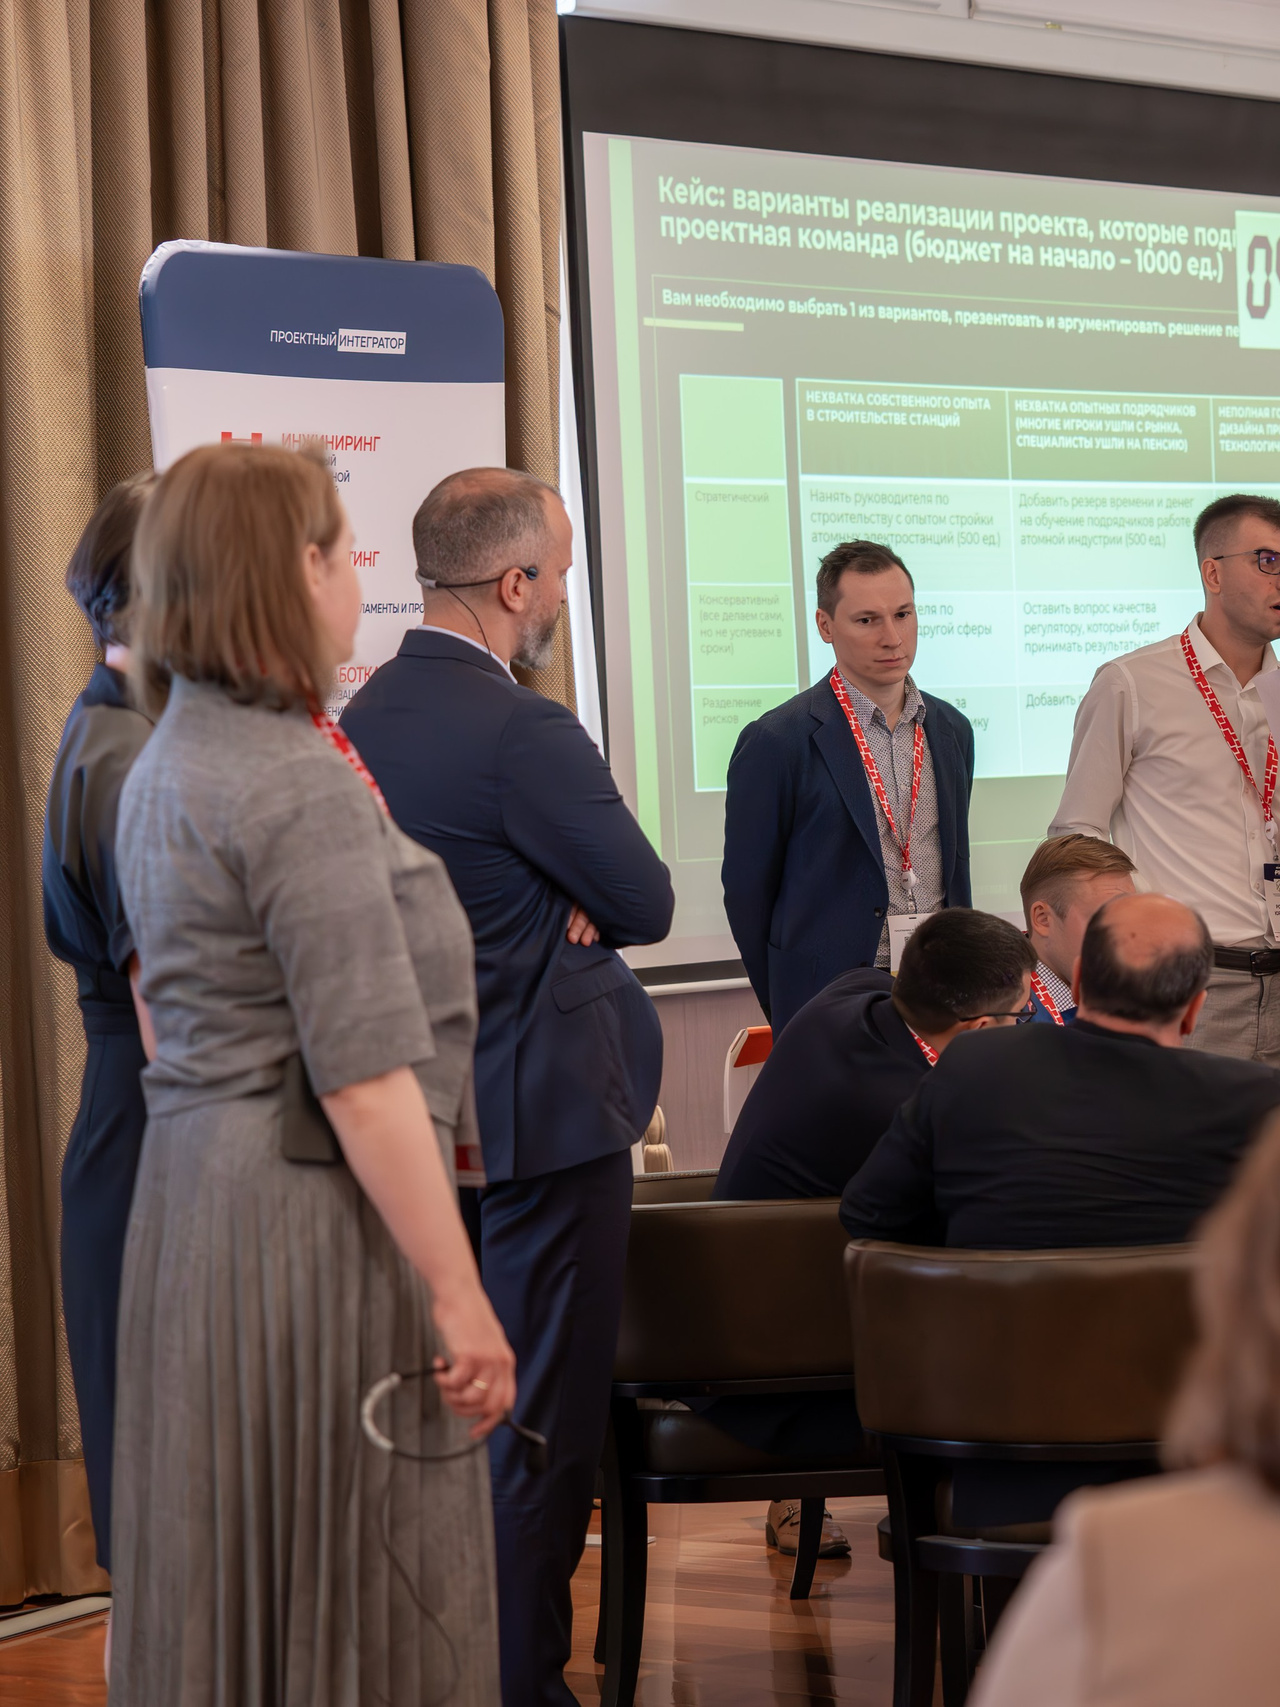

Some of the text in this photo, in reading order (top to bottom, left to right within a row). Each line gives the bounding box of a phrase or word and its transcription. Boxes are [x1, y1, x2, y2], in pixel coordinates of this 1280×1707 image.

[658, 176, 725, 208] Кейс:
[732, 188, 850, 219] варианты
[856, 199, 994, 233] реализации
[1000, 211, 1094, 242] проекта,
[1099, 219, 1189, 248] которые
[660, 215, 1224, 284] проектная команда (бюджет на начало 1000 ед.)
[662, 289, 692, 306] Вам
[695, 292, 785, 313] необходимо
[788, 298, 847, 318] выбрать
[849, 302, 856, 317] 1
[859, 305, 875, 318] из
[878, 305, 953, 326] вариантов,
[954, 309, 1044, 328] презентовать
[1046, 316, 1055, 328] и
[1057, 316, 1166, 336] аргументировать
[1168, 322, 1223, 338] решение
[270, 330, 405, 350] ПРОЕКТНЫЙ ИНТЕГРАТОР
[806, 390, 991, 410] НЕХВАТКА СОБСТВЕННОГО ОПЫТА
[1015, 399, 1196, 417] НЕХВАТКА ОПЫТНЫХ ПОДРЯДЧИКОВ
[807, 409, 960, 428] В СТРОИТЕЛЬСТВЕ СТАНЦИЙ
[1218, 406, 1270, 419] НЕПОЛНАЯ
[1015, 417, 1182, 435] (МНОГИЕ ИГРОКИ УШЛИ С РЫНКА,
[1219, 421, 1264, 436] ДИЗАЙНА
[1016, 434, 1188, 453] СПЕЦИАЛИСТЫ УШЛИ НА ПЕНСИЮ)
[695, 490, 769, 504] Стратегический
[810, 489, 949, 507] Нанять руководителя по
[1018, 493, 1195, 510] Добавить резерв времени и денег
[810, 511, 994, 528] строительству с опытом стройки
[1020, 513, 1191, 530] на обучение подрядчиков работе
[957, 532, 979, 547] (500
[982, 532, 1001, 547] ед.)
[1020, 533, 1166, 548] атомной индустрии (500 ед.)
[359, 602, 399, 614] ЛАМЕНТЫ
[401, 603, 408, 614] И
[699, 594, 780, 607] Консервативный
[700, 609, 785, 623] (все делаем сами,
[939, 605, 954, 616] по
[1023, 601, 1157, 617] Оставить вопрос качества
[700, 627, 782, 640] но не успеваем в
[917, 621, 993, 639] другой сферы
[1024, 618, 1161, 637] регулятору, который будет
[700, 643, 734, 656] сроки)
[1024, 641, 1082, 654] принимать
[702, 697, 762, 709] Разделение
[1026, 693, 1076, 709] Добавить
[703, 714, 739, 726] рисков
